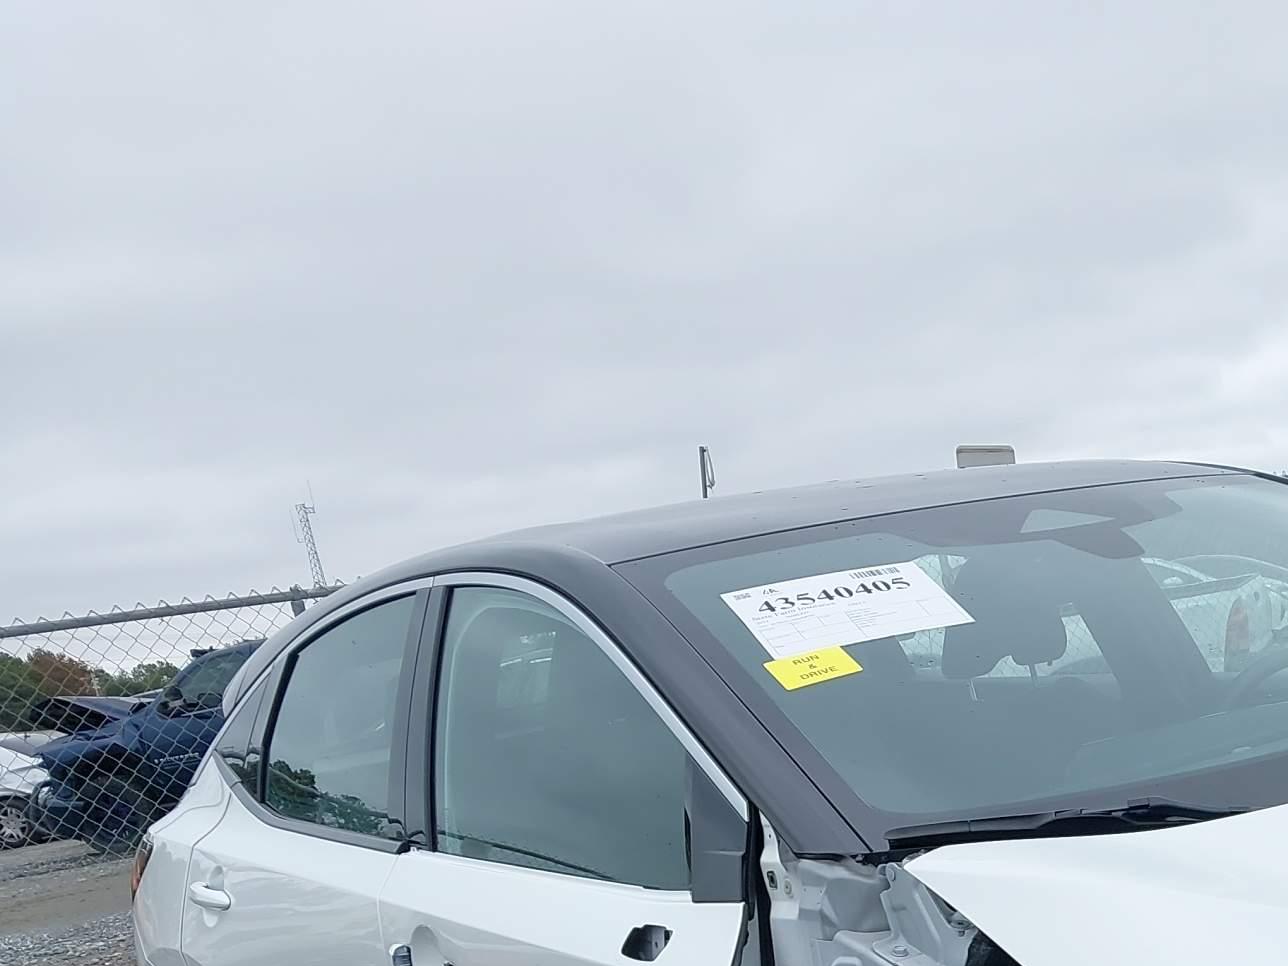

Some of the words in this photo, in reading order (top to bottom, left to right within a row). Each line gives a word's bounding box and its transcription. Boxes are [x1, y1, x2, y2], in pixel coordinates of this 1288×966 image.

[758, 576, 911, 613] 43540405
[792, 654, 820, 666] RUN
[799, 665, 839, 680] DRIVE
